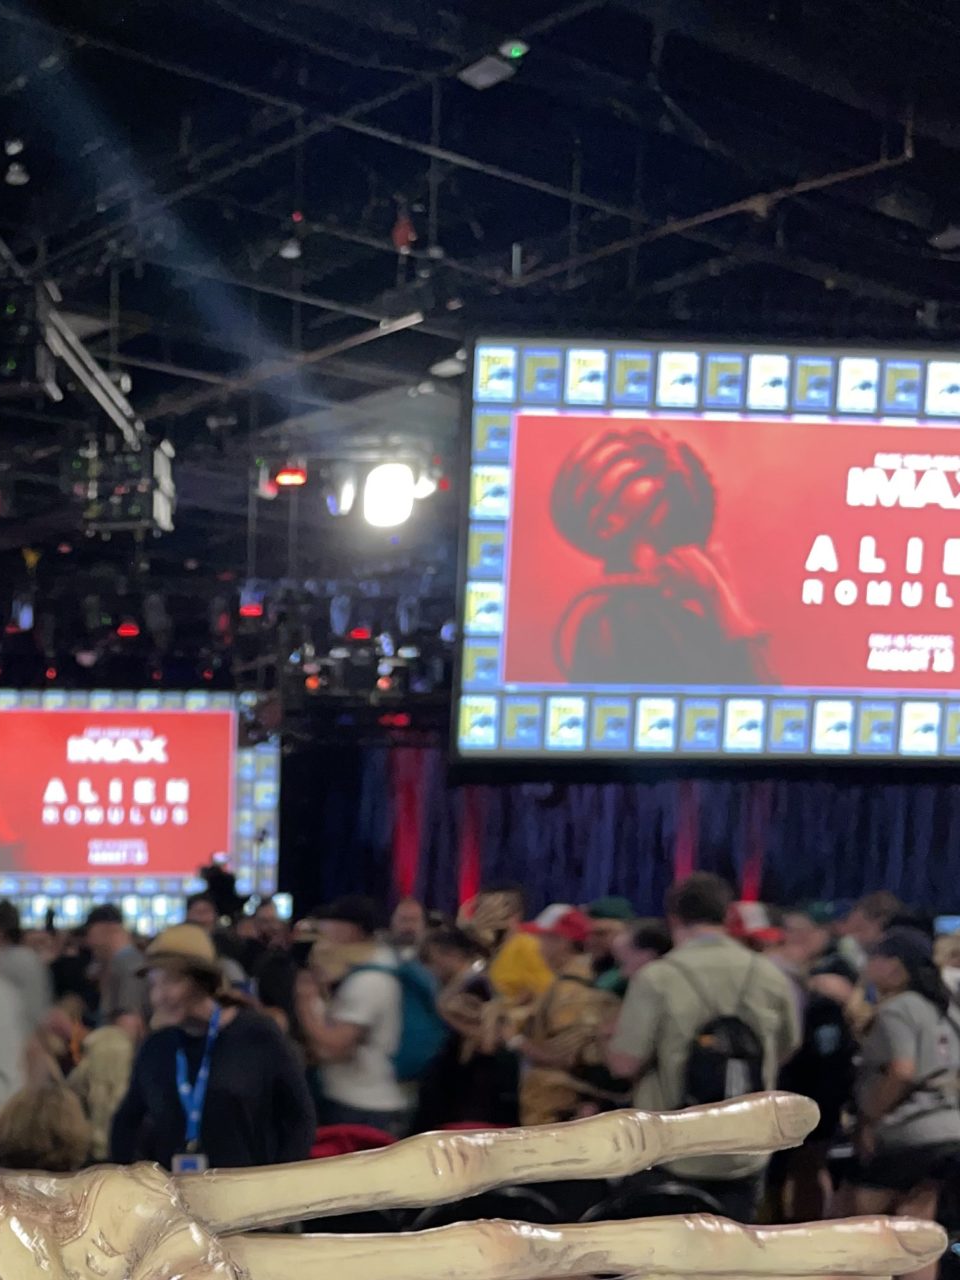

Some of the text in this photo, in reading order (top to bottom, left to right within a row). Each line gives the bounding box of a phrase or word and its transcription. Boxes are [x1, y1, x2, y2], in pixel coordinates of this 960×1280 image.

[846, 466, 960, 509] IMA
[802, 579, 953, 608] ROMUL
[43, 777, 189, 804] ALIEN
